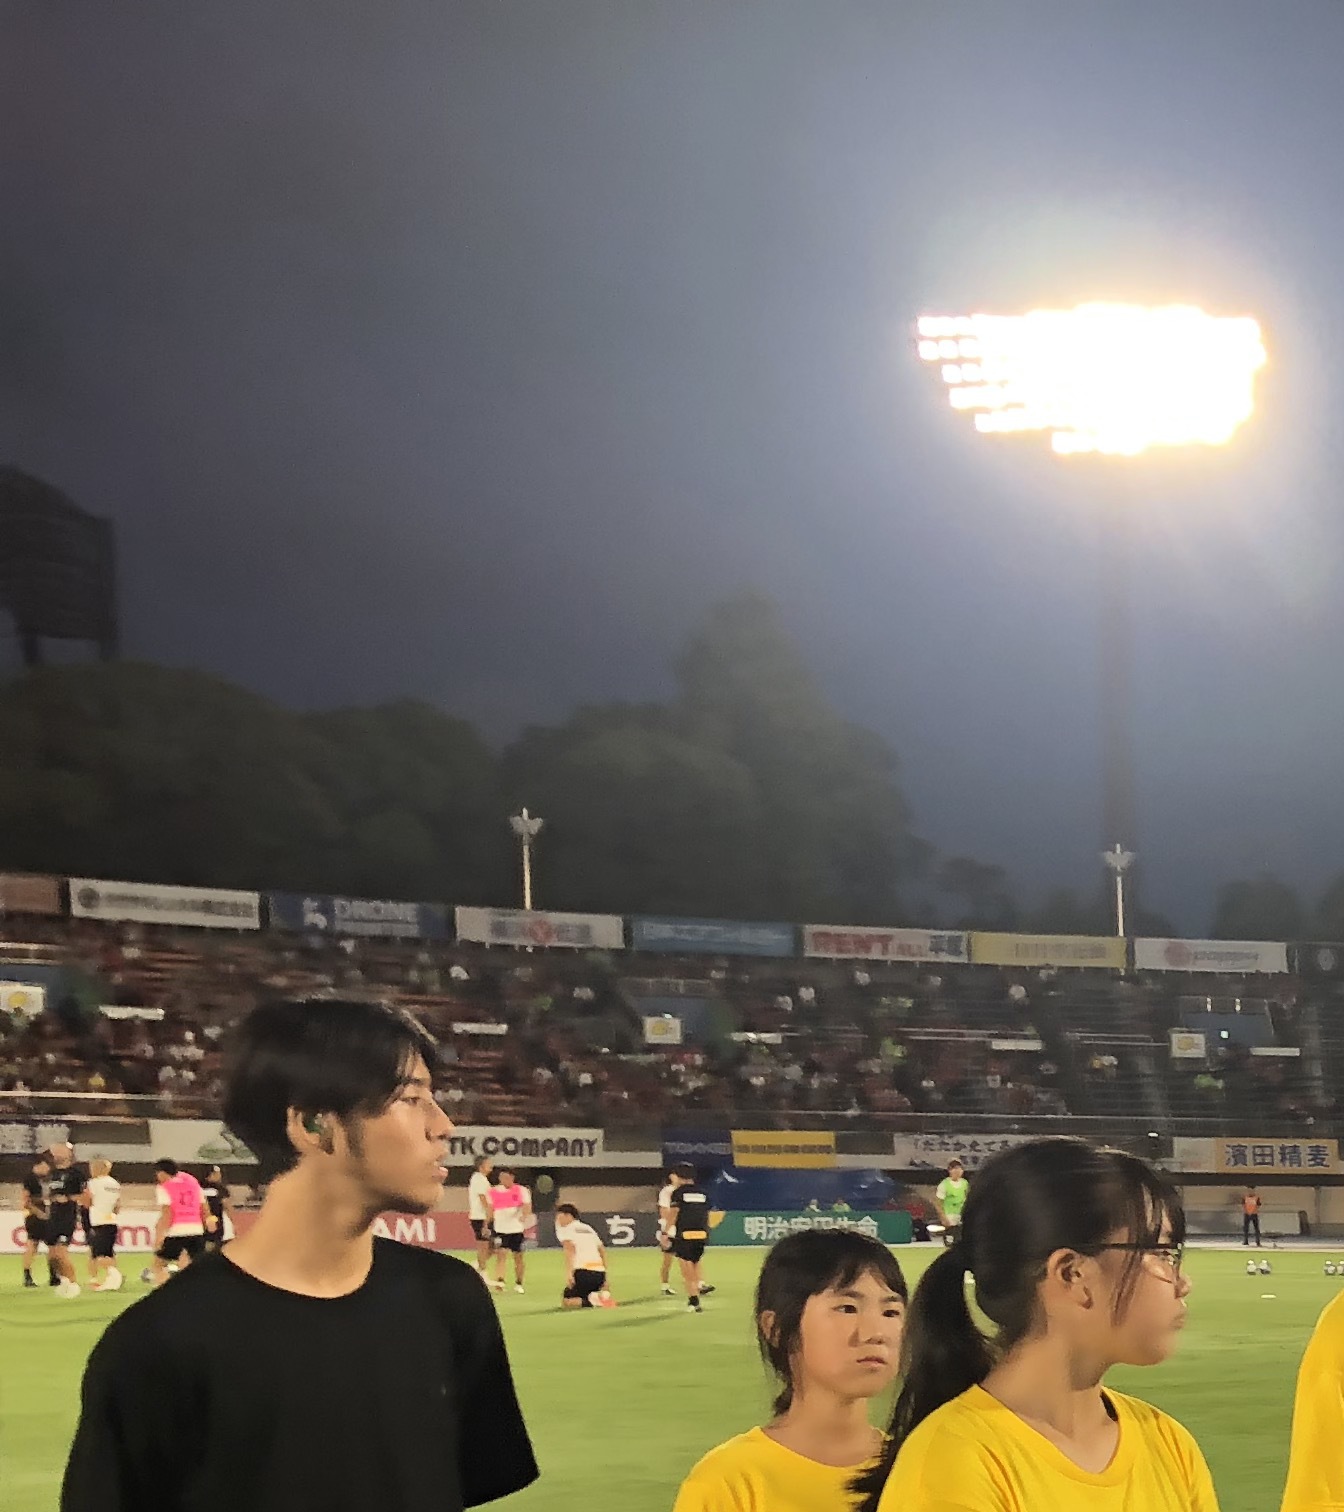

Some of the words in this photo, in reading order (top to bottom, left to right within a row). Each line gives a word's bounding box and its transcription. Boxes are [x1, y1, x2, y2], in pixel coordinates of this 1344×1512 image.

[482, 1136, 597, 1158] COMPANY
[1225, 1143, 1330, 1168] 濱田精麦
